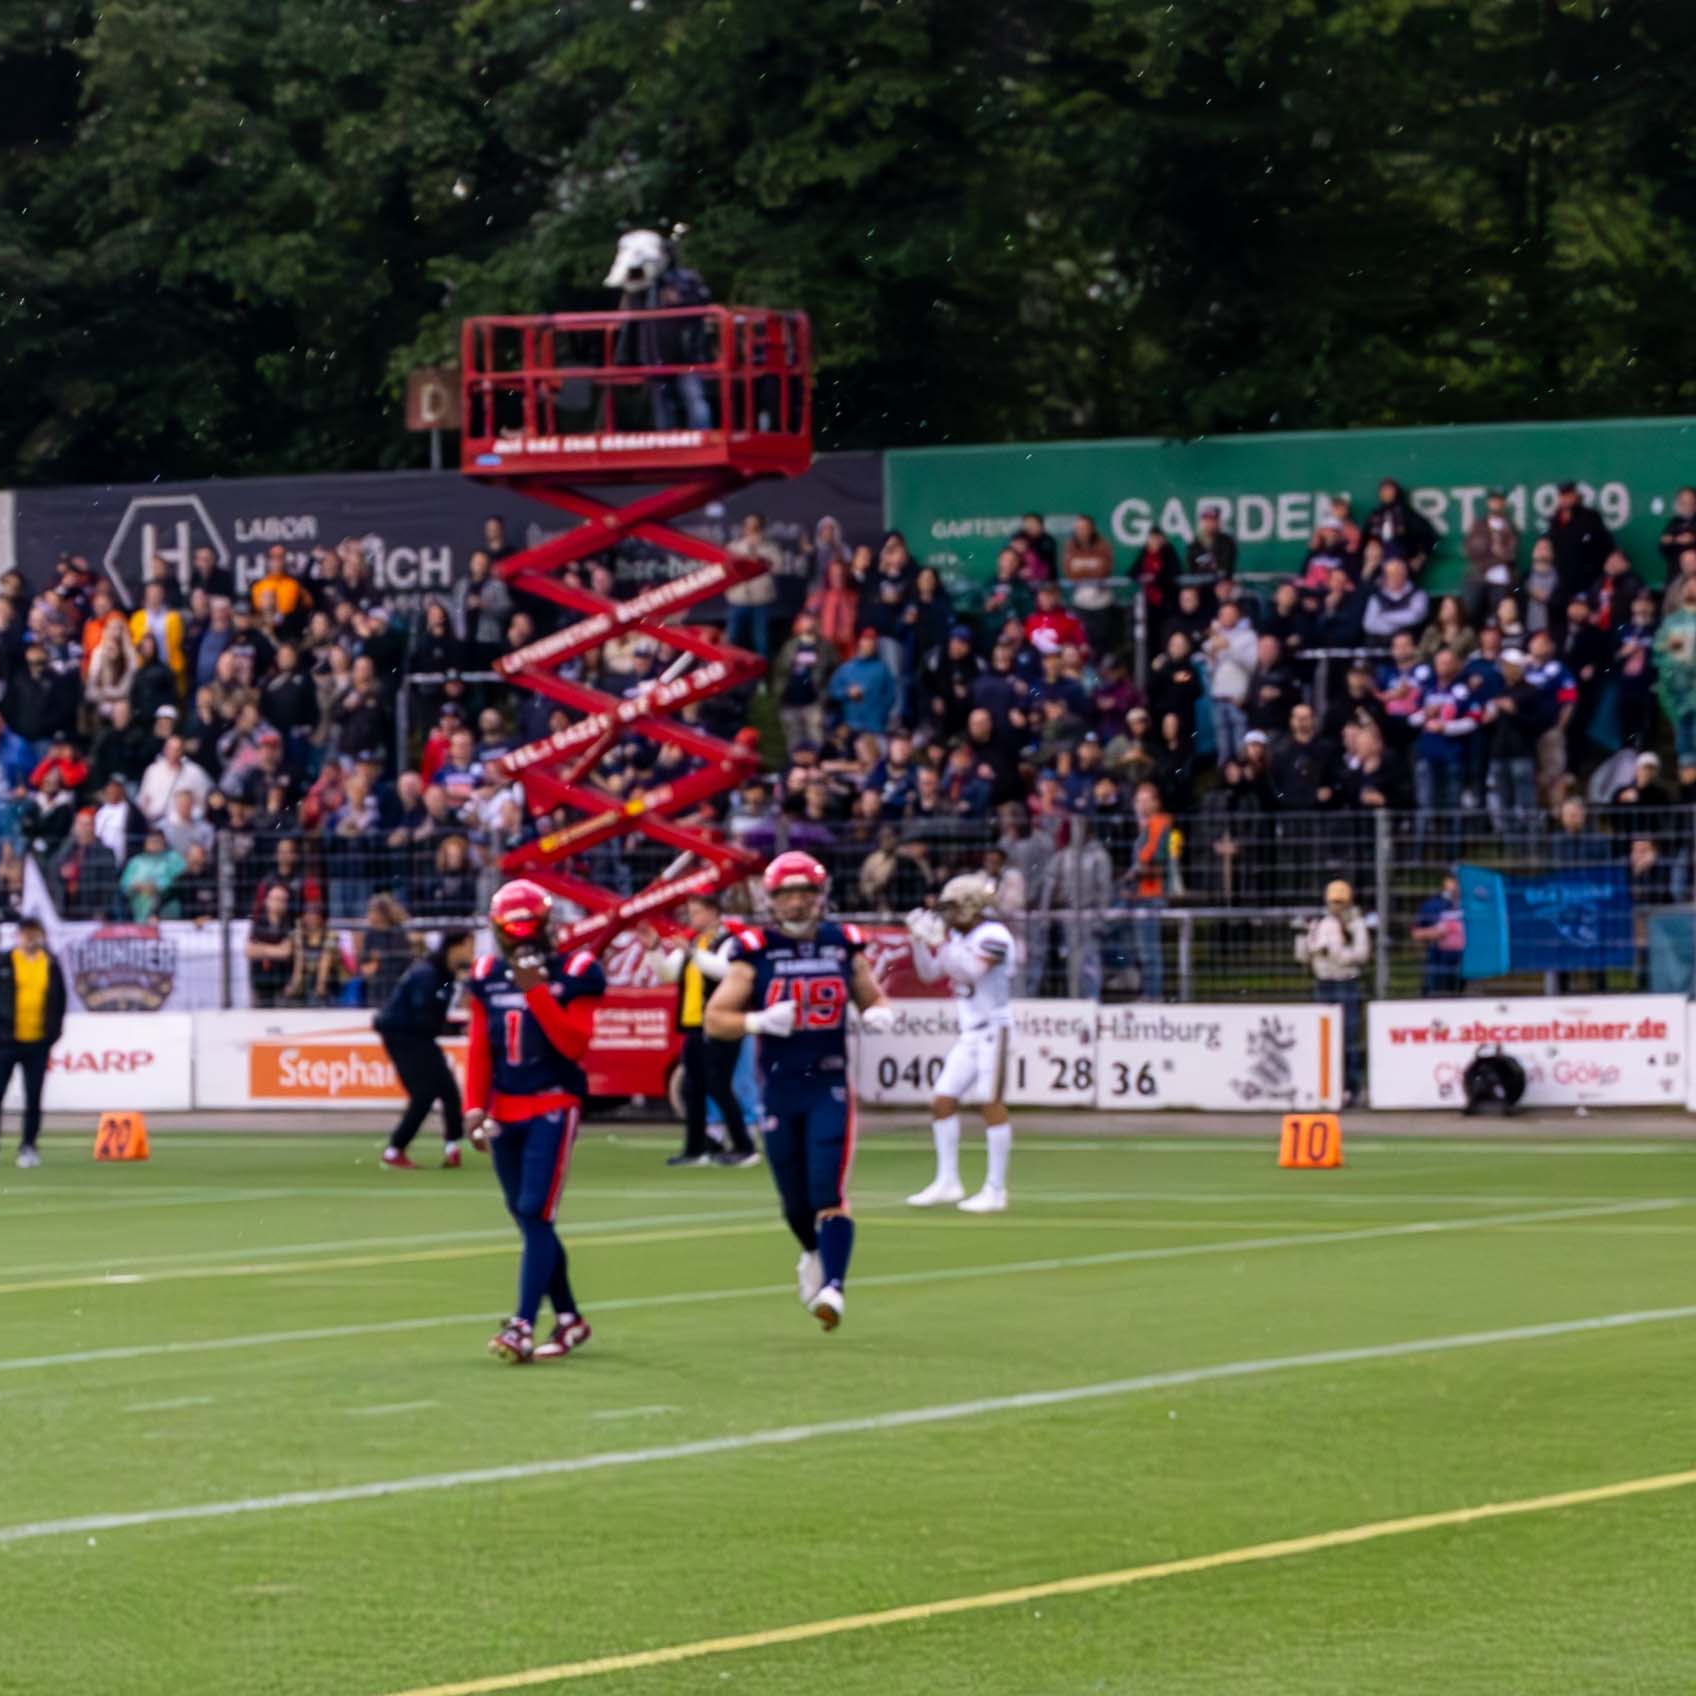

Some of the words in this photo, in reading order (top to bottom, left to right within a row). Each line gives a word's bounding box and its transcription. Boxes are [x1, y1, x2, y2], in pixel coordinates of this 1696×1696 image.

[234, 515, 318, 542] LABOR
[505, 1010, 522, 1066] 1
[1389, 1019, 1667, 1044] www.abccontainer.de
[48, 1049, 154, 1072] HARP
[1050, 1058, 1093, 1090] 28
[1112, 1063, 1156, 1095] 36
[1291, 1122, 1327, 1161] 10
